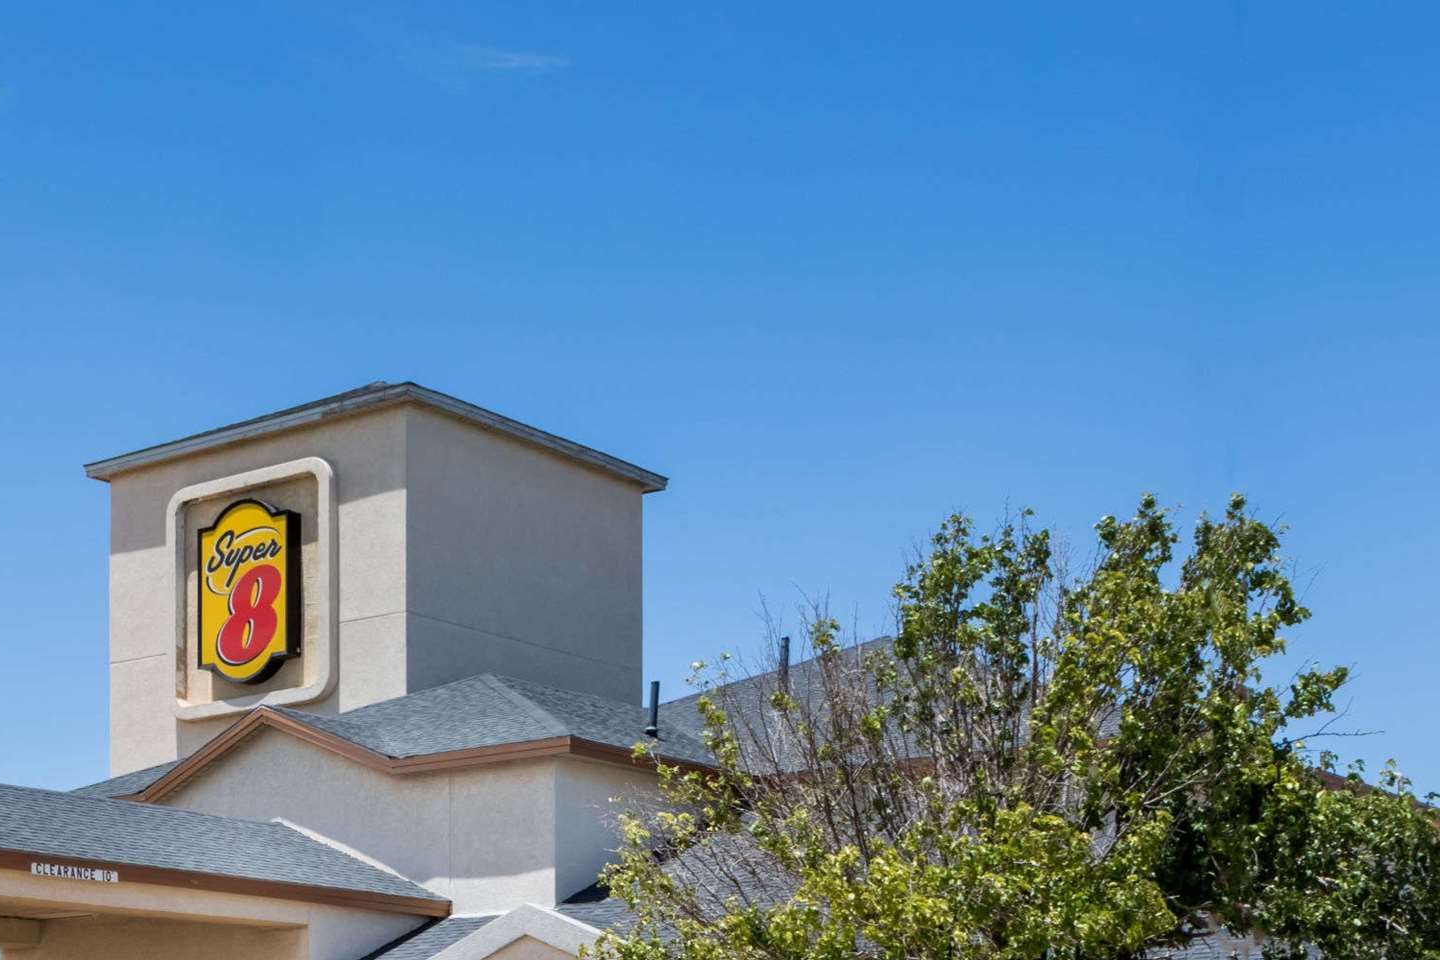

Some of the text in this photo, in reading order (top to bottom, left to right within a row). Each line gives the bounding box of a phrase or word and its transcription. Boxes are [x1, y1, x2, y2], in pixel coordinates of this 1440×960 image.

[207, 530, 282, 588] Super
[216, 564, 282, 666] 8
[35, 863, 96, 881] CLEARANCE
